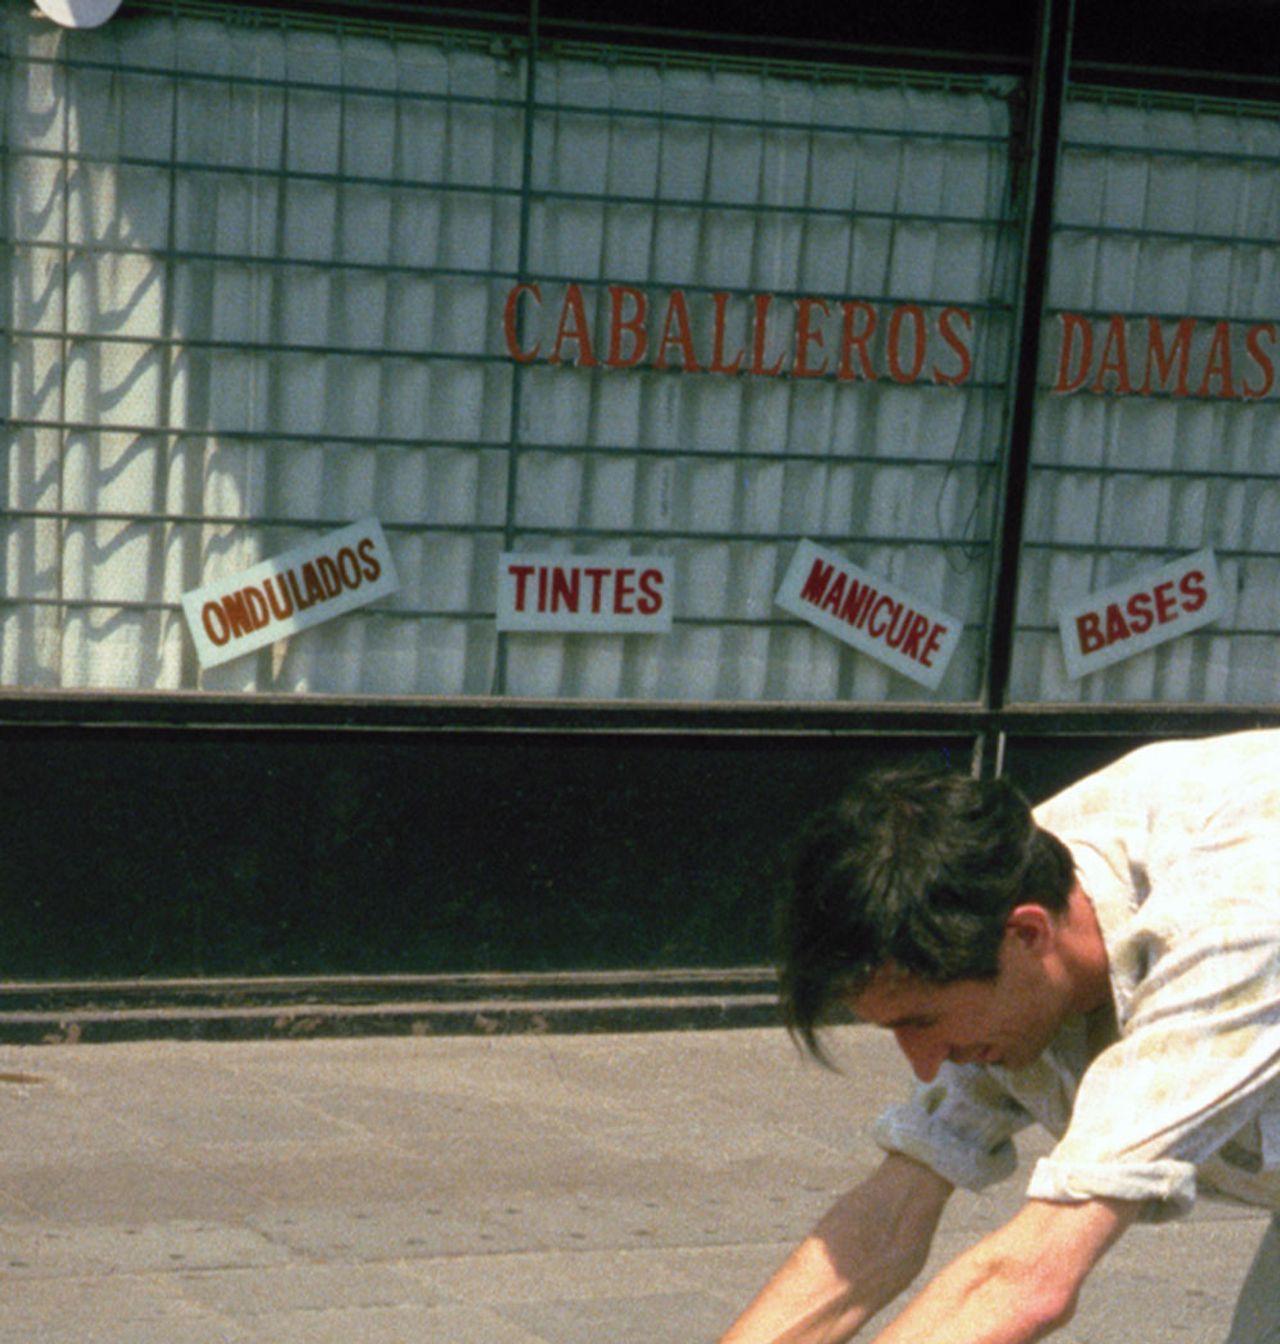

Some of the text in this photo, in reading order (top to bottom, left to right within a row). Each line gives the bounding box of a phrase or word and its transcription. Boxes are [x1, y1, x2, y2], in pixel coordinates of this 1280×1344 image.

[503, 282, 975, 385] CABALLEROS
[1052, 312, 1277, 400] DAMAS
[201, 538, 382, 647] ONDULADOS
[508, 565, 664, 615] TINTES
[799, 558, 947, 669] MANICURE
[1075, 569, 1208, 655] BASES
